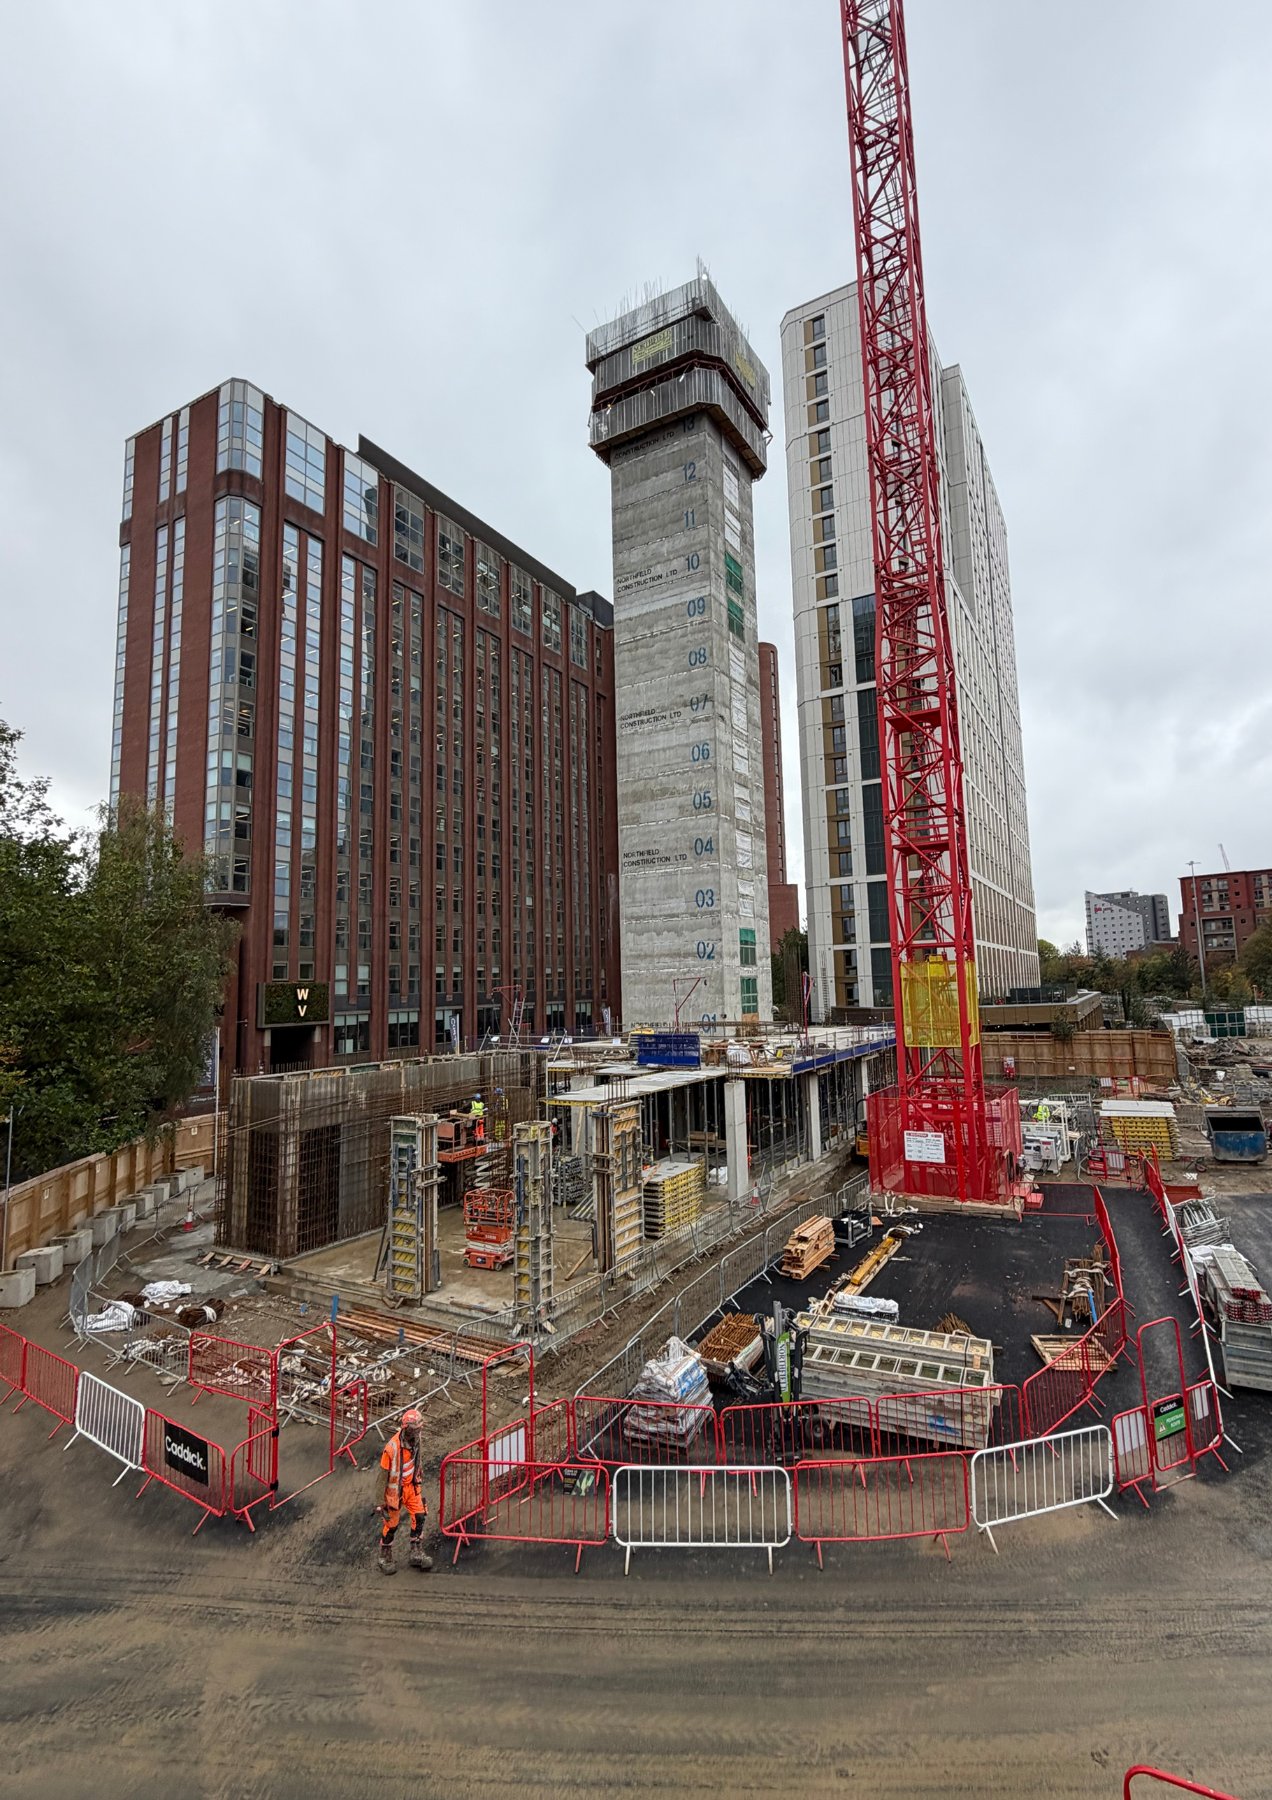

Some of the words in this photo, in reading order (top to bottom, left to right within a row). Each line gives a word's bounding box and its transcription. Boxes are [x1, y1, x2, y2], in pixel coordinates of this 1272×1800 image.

[682, 461, 696, 481] 12
[684, 509, 695, 527] 11
[686, 553, 700, 572] 10
[616, 568, 652, 585] NORTHFIELD
[617, 574, 663, 593] CONSTRUCTION
[666, 569, 678, 578] LTD
[687, 596, 706, 618] 09
[688, 647, 707, 667] 08
[690, 694, 708, 712] 07
[620, 708, 656, 722] NORTHFIELD
[620, 715, 667, 729] CONSTRUCTION
[669, 711, 682, 719] LTD
[691, 742, 710, 762] 06
[692, 790, 712, 810] 05
[623, 848, 660, 859] NORTHFIELD
[694, 836, 714, 856] 04
[623, 856, 671, 868] CONSTRUCTION
[674, 853, 688, 862] LTD
[695, 889, 714, 908] 03
[697, 941, 715, 960] 02
[297, 988, 309, 1000] W
[298, 1005, 307, 1017] V
[701, 1013, 717, 1033] 01
